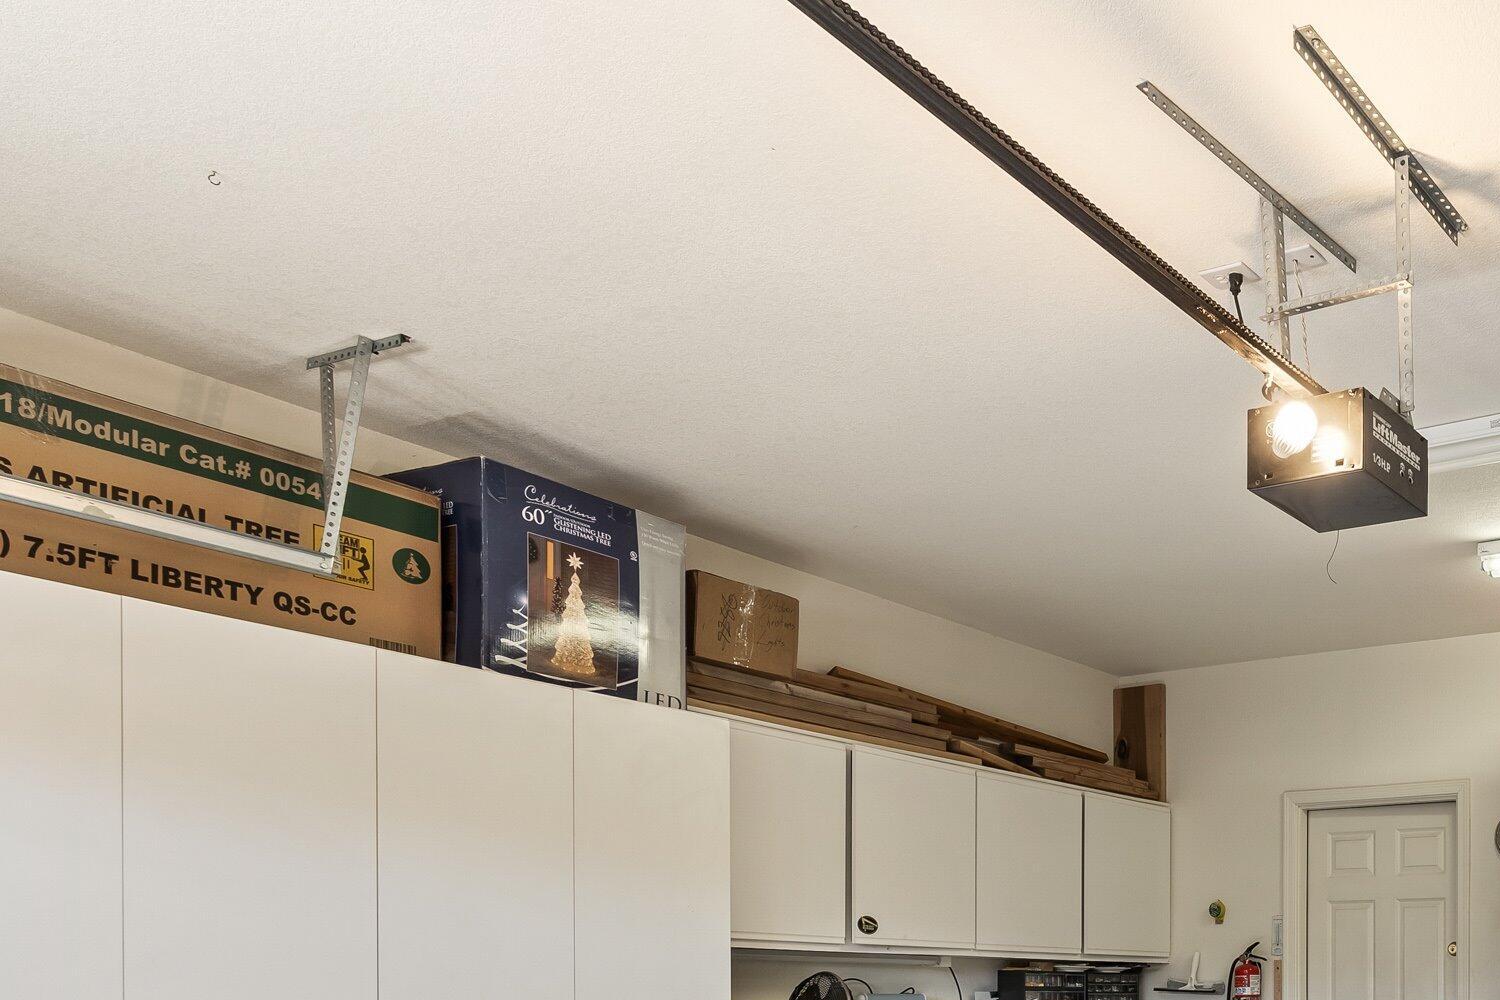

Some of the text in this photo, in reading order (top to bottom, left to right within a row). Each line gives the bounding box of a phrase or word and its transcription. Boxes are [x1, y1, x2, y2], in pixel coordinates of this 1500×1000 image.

[1373, 416, 1420, 465] LiftMaster
[259, 467, 322, 500] 0054
[524, 484, 598, 522] Celebrations
[553, 517, 612, 541] GLISTENING LED
[553, 524, 611, 547] CHRISTMAS TREE
[24, 534, 119, 575] 7.5FT
[131, 558, 264, 606] LIBERTY
[273, 591, 357, 626] QS-CC
